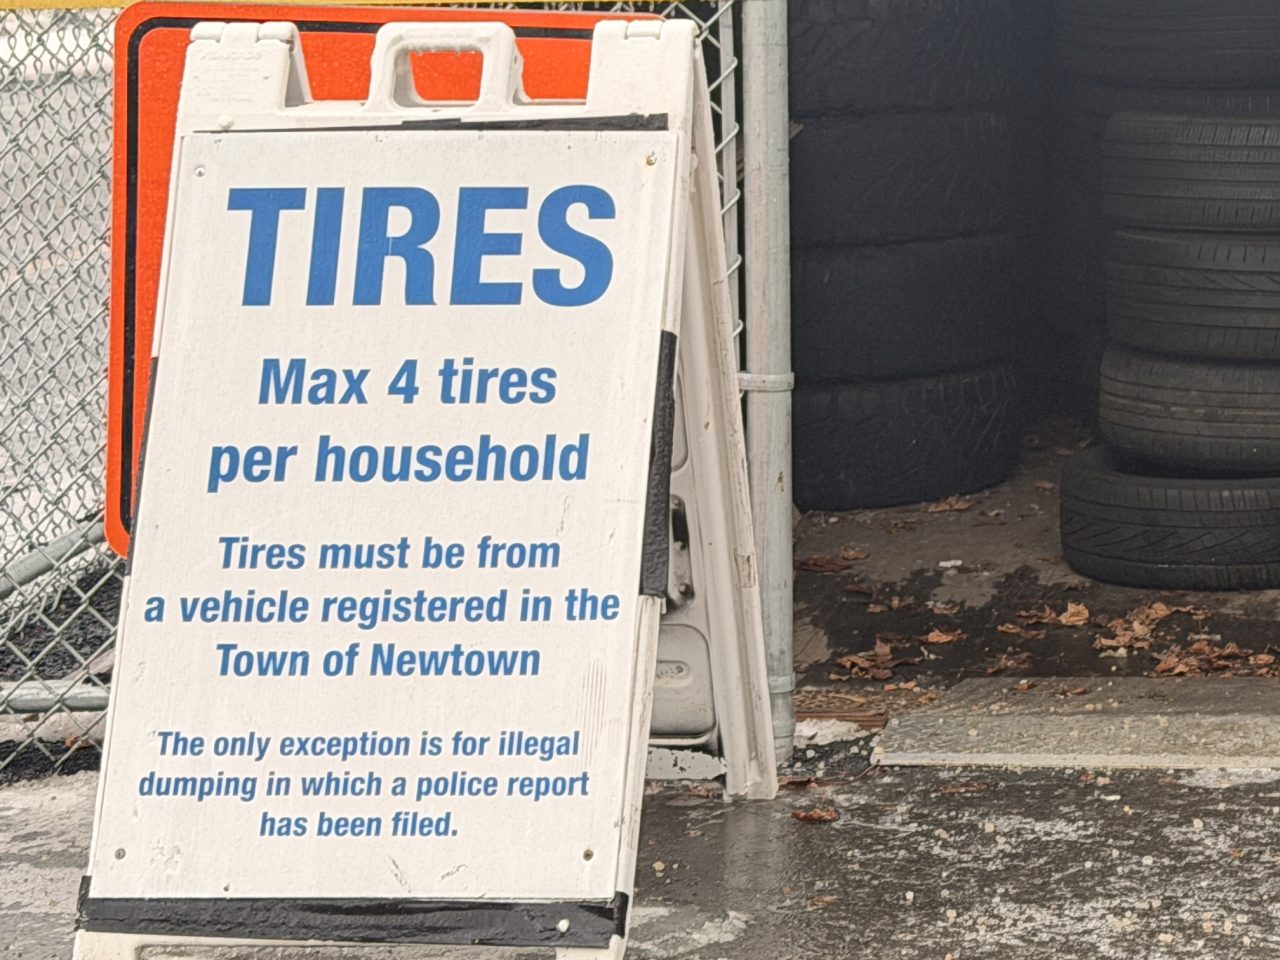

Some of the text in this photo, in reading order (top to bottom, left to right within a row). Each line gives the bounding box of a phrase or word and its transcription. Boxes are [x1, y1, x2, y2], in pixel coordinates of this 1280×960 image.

[227, 185, 615, 307] TIRES
[259, 358, 556, 405] Max 4 tires
[208, 434, 589, 493] per household
[219, 536, 560, 569] Tires must be from
[145, 589, 619, 630] a vehicle registered in the
[217, 643, 539, 676] Town of Newtown
[158, 731, 579, 761] The only exception is for illegal
[139, 772, 589, 801] dumping in which a police report
[260, 812, 457, 836] has been filed.
